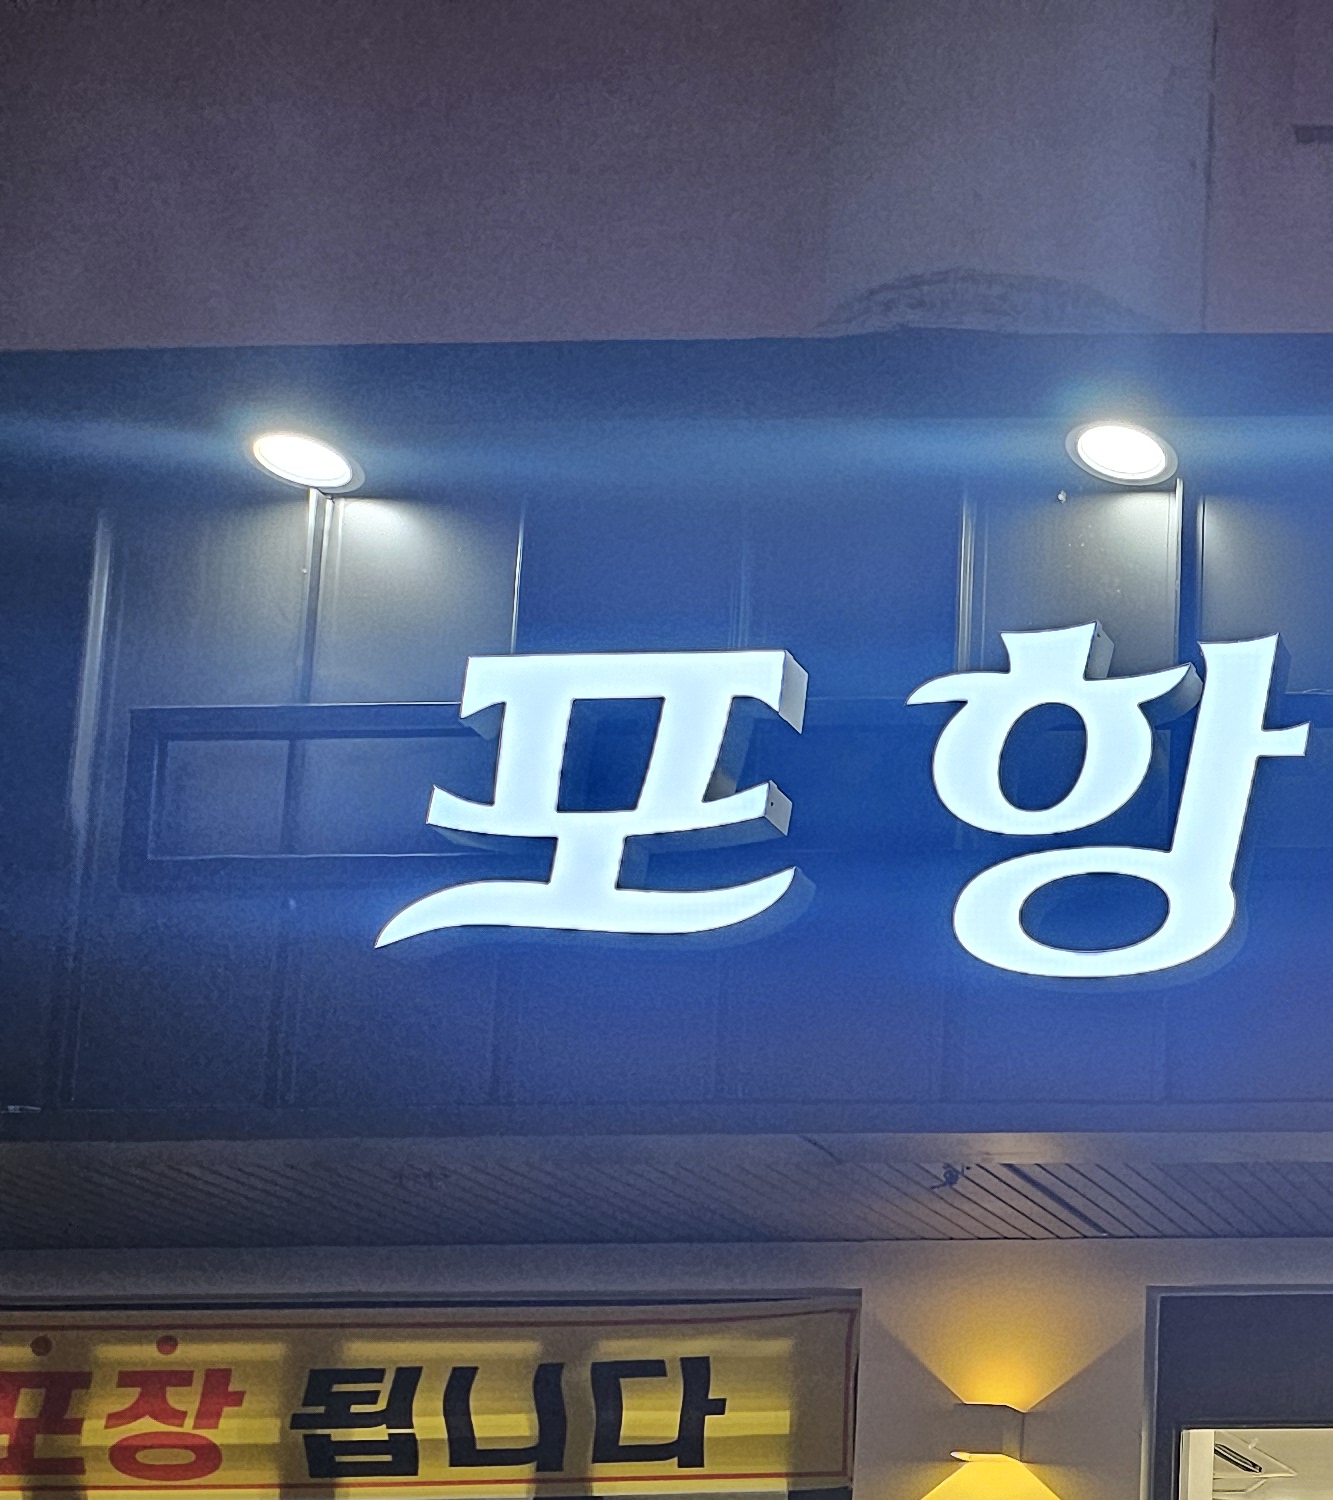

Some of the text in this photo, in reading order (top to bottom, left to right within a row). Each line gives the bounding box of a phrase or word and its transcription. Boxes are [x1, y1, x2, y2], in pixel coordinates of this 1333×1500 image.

[372, 620, 1310, 980] 포항
[0, 1356, 727, 1481] 포장 됩니다
